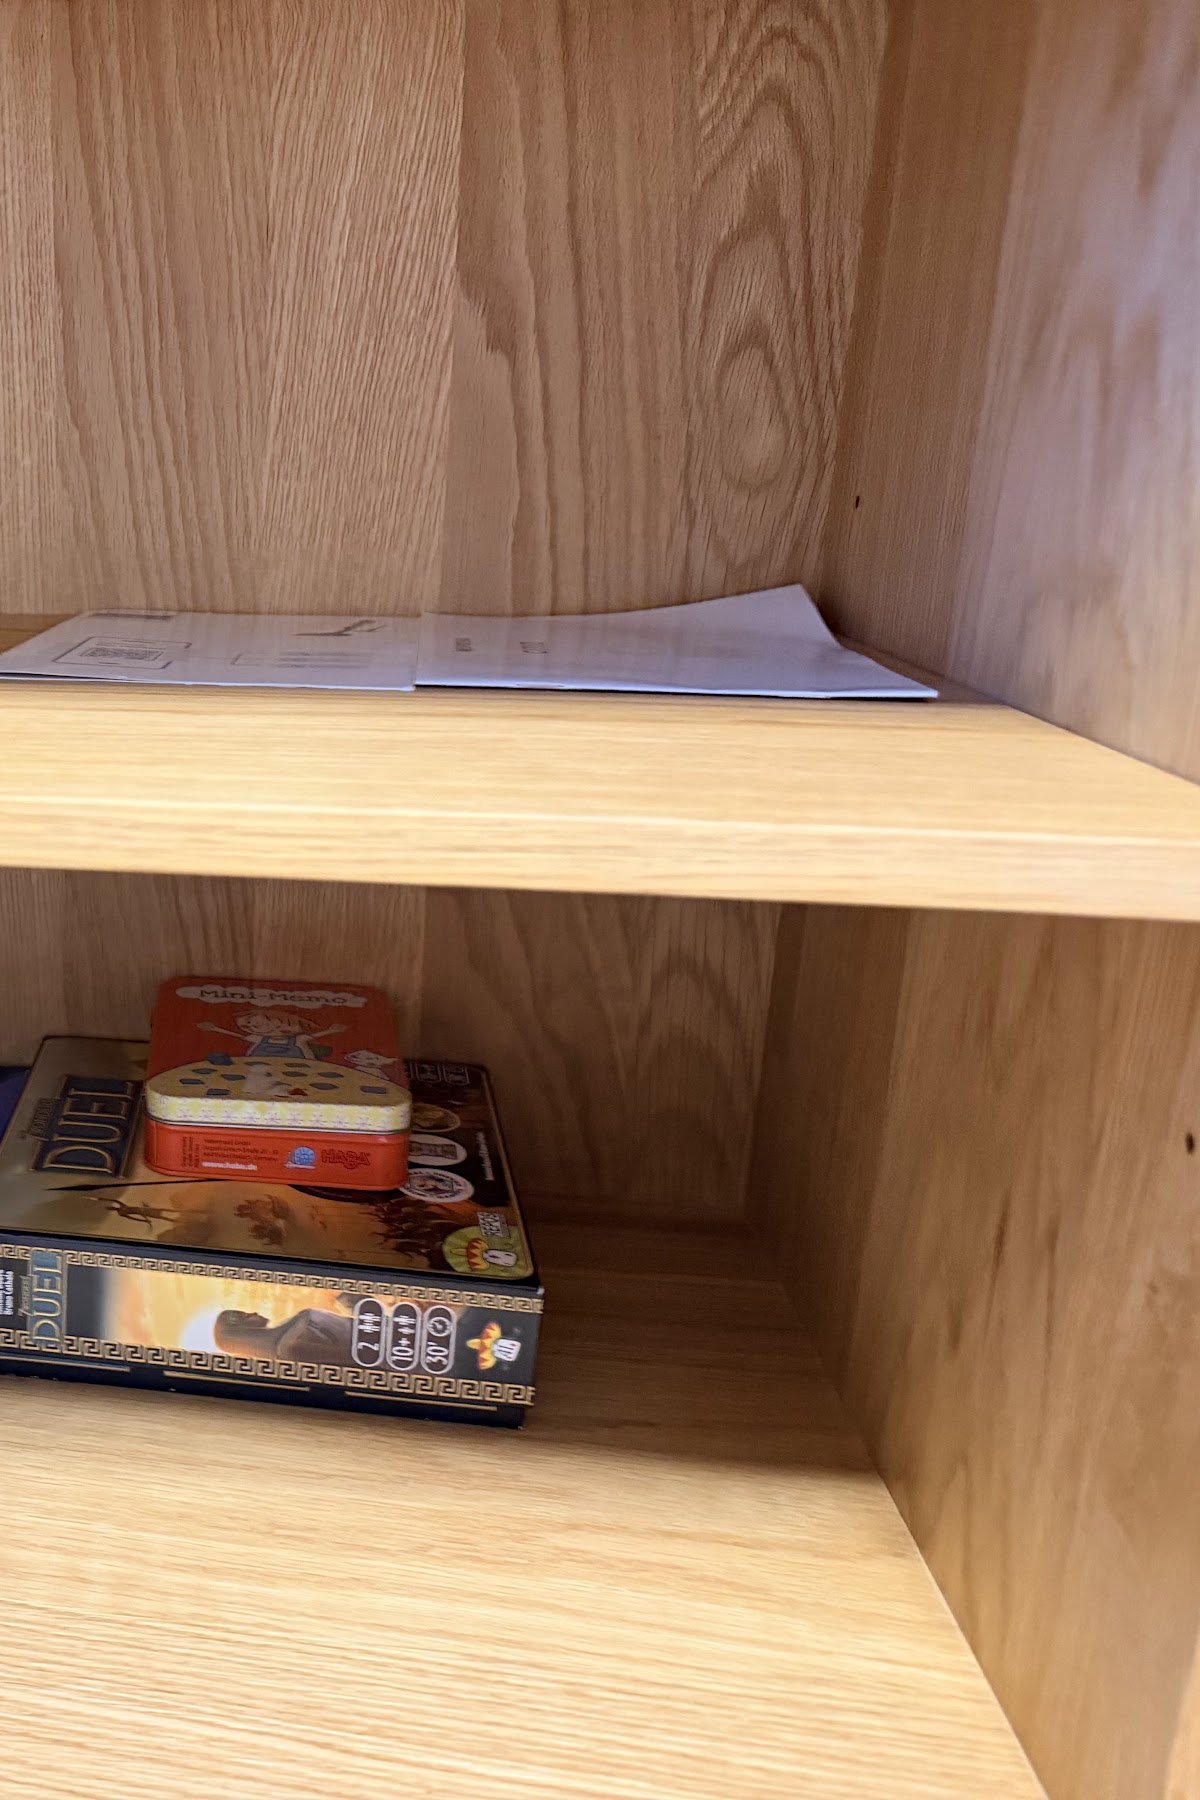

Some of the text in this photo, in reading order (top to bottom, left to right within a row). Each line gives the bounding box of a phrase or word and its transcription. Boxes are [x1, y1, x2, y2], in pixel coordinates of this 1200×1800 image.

[200, 989, 348, 1005] Mini-Memo
[43, 1081, 133, 1174] DUEL
[321, 1147, 371, 1171] HABA
[31, 1255, 62, 1342] DUEL
[357, 1342, 380, 1351] 2
